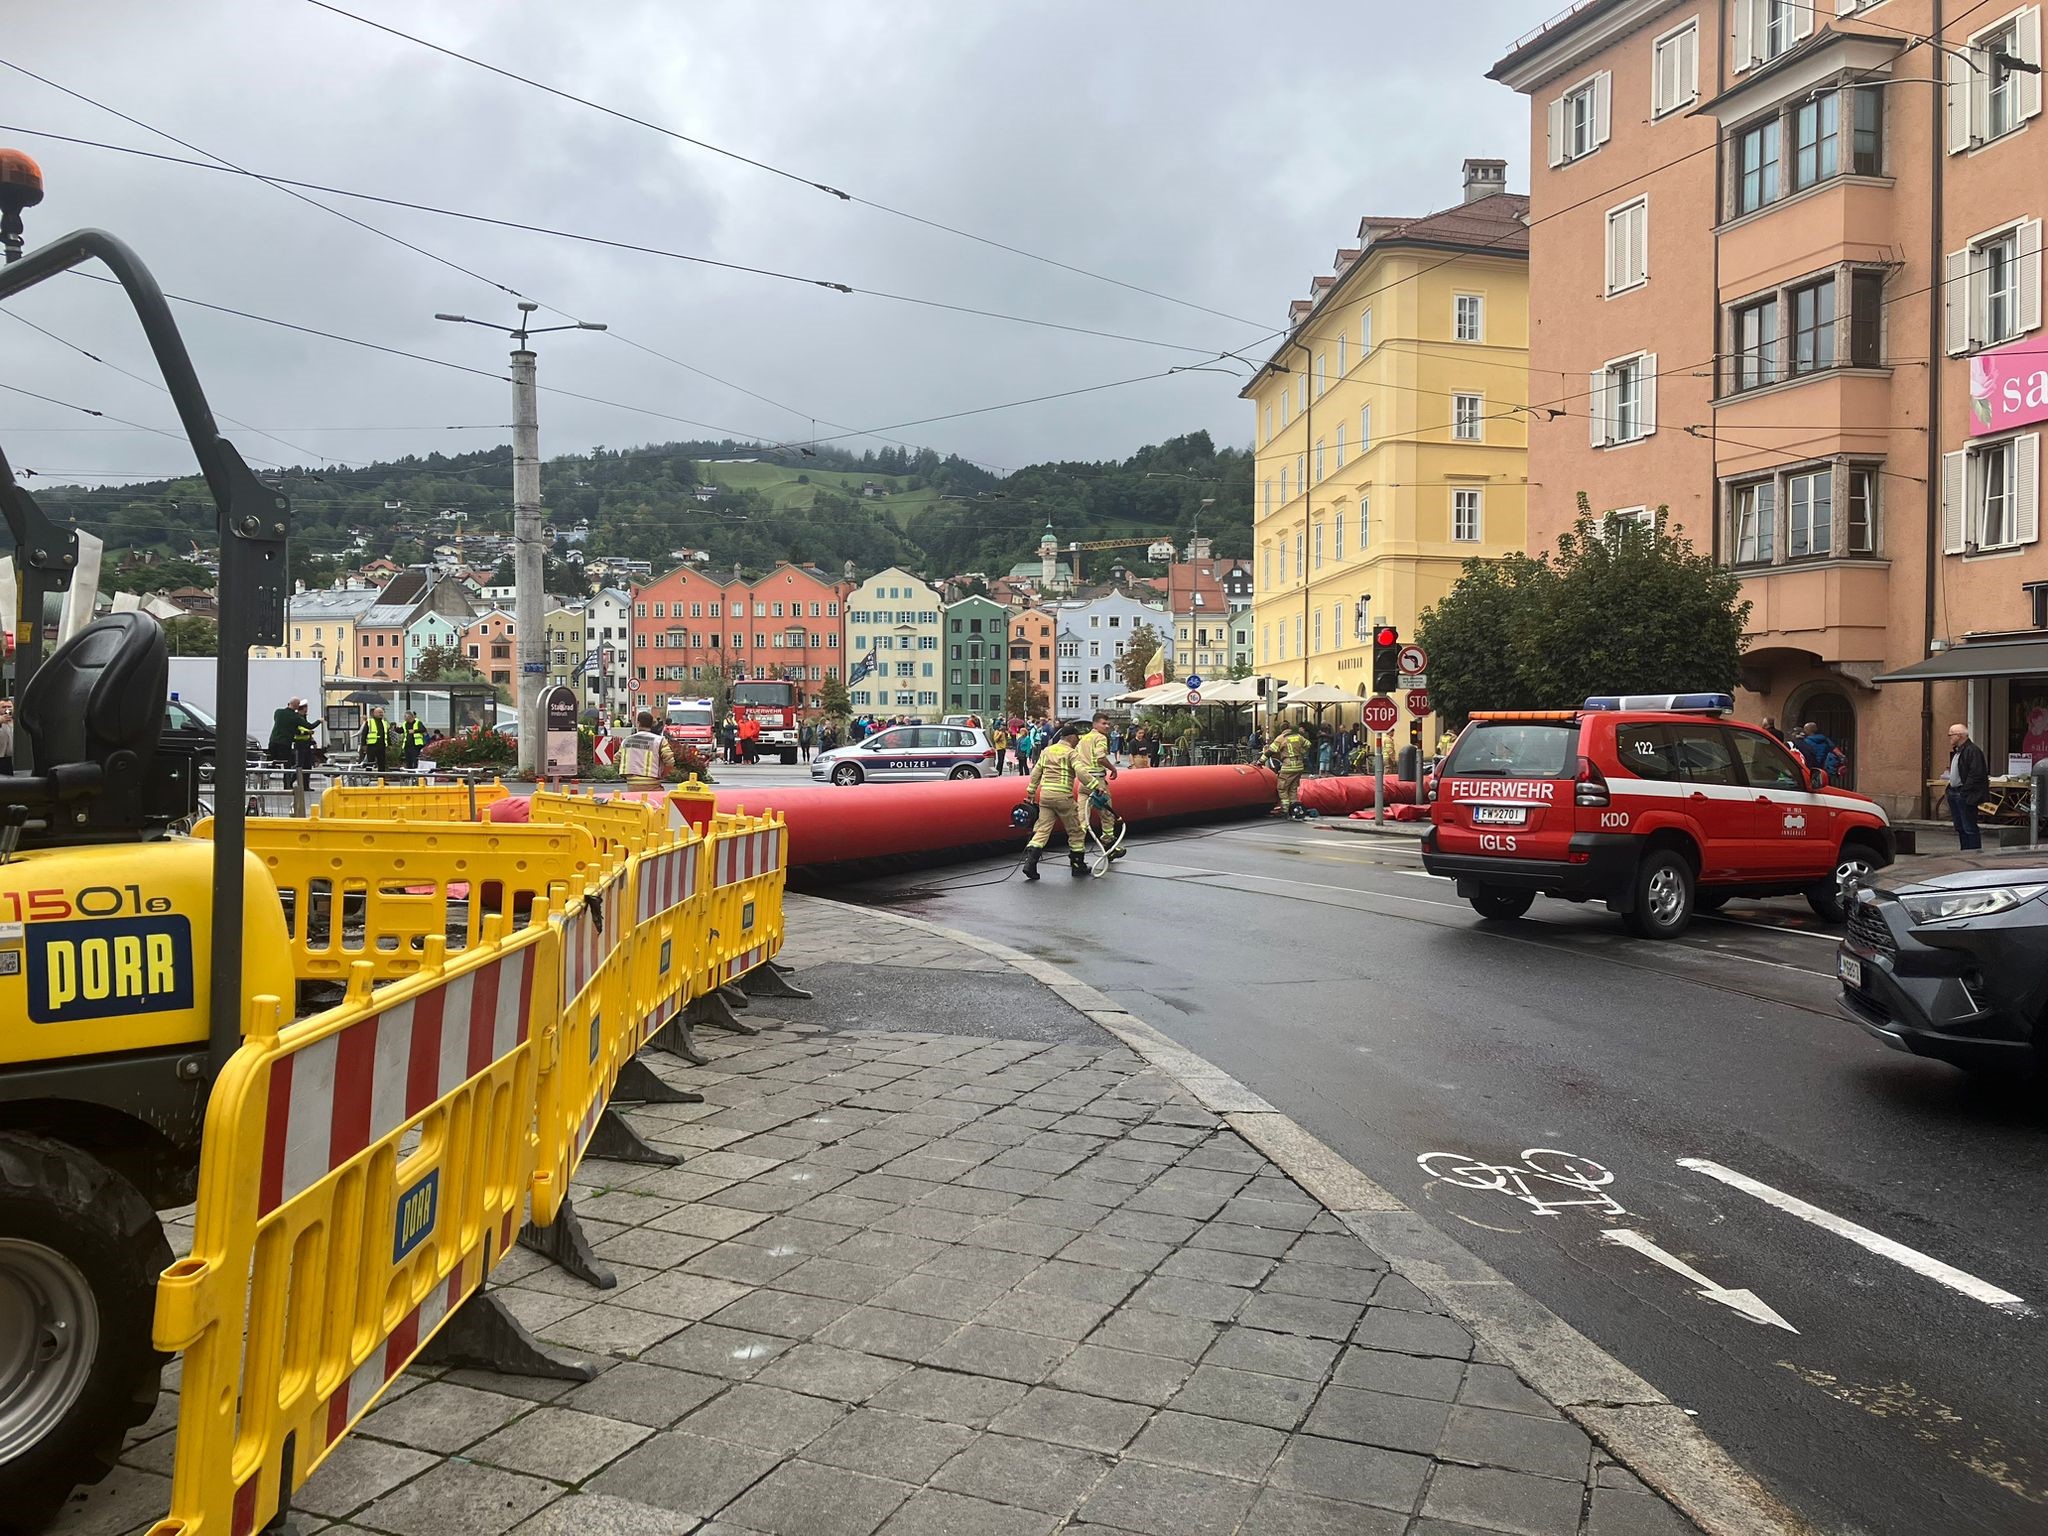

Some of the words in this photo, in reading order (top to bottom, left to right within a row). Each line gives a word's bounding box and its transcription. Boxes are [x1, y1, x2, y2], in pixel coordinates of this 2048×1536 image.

[1409, 695, 1428, 708] STO
[1365, 707, 1395, 721] STOP
[1634, 741, 1655, 755] 122
[889, 760, 930, 769] POLIZEI
[1451, 781, 1554, 800] FEUERWEHR
[1481, 808, 1494, 819] FW
[1601, 812, 1630, 828] KDO
[1479, 834, 1517, 852] IGLS
[46, 933, 175, 1010] PORR
[401, 1182, 432, 1249] PORR
